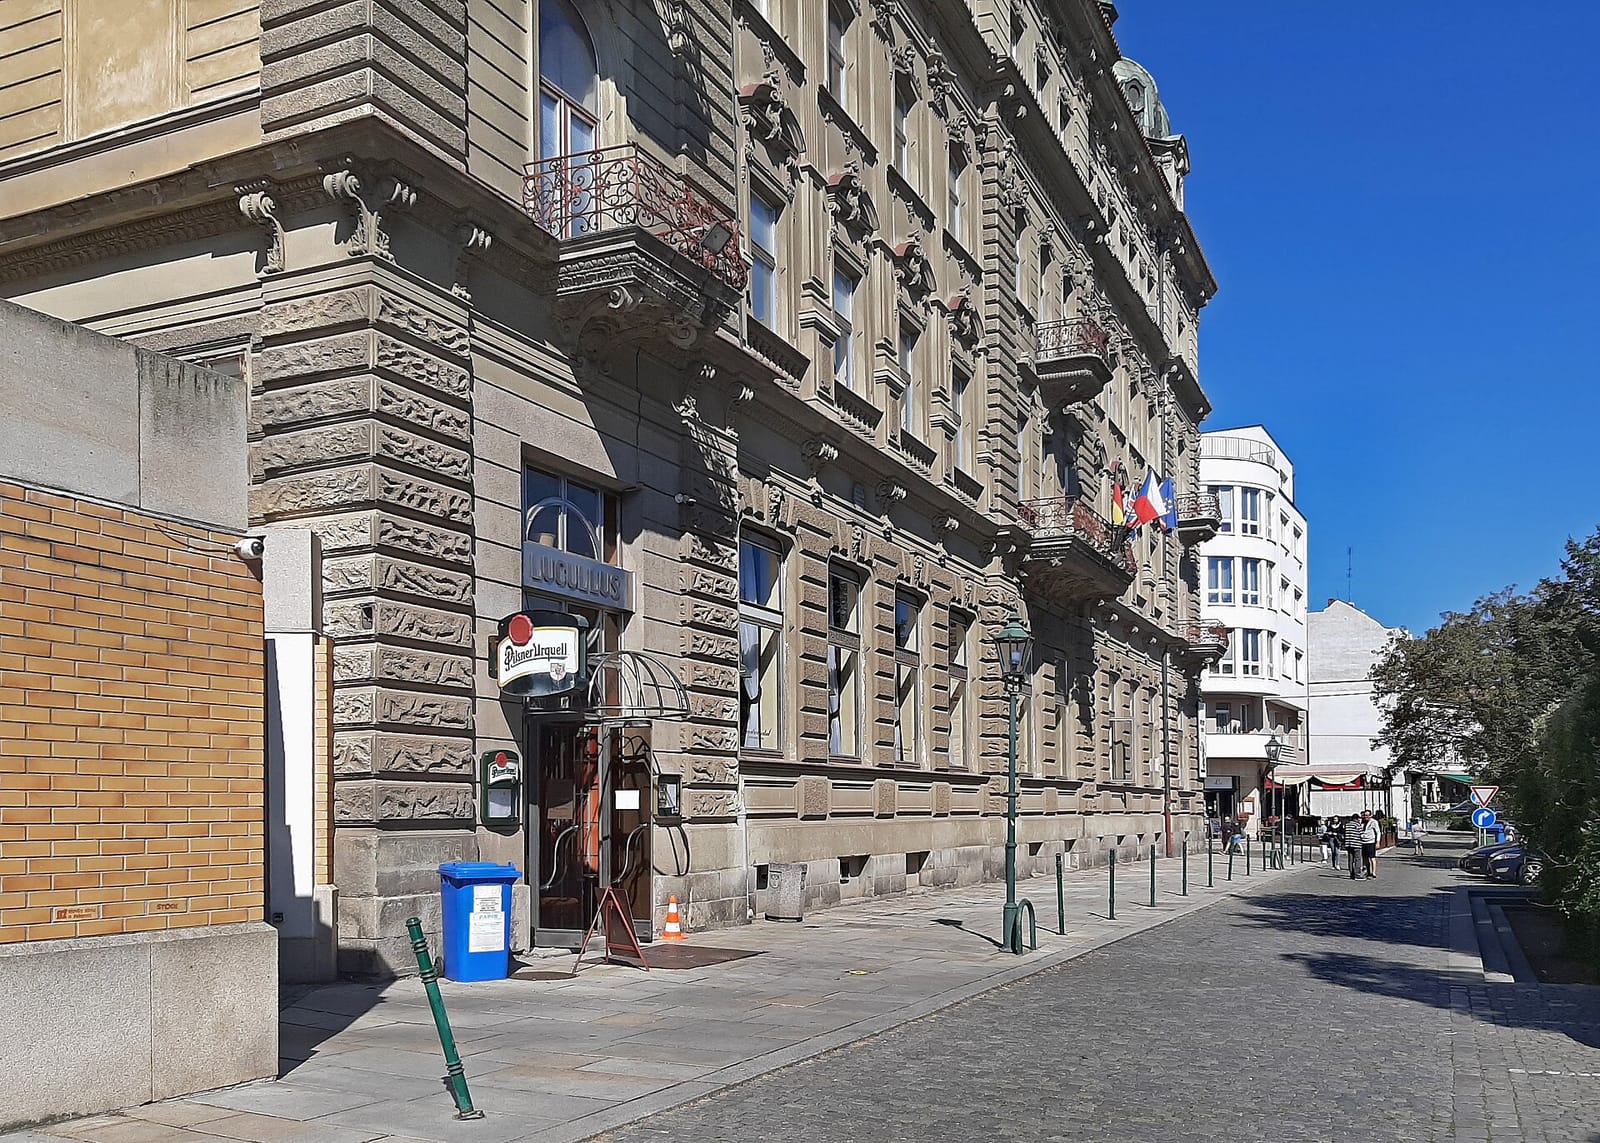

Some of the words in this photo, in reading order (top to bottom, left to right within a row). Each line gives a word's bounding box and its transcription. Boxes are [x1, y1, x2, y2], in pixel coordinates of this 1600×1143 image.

[528, 551, 621, 602] LUCULLUS
[504, 645, 534, 672] Pilsner
[533, 642, 568, 662] Urquell
